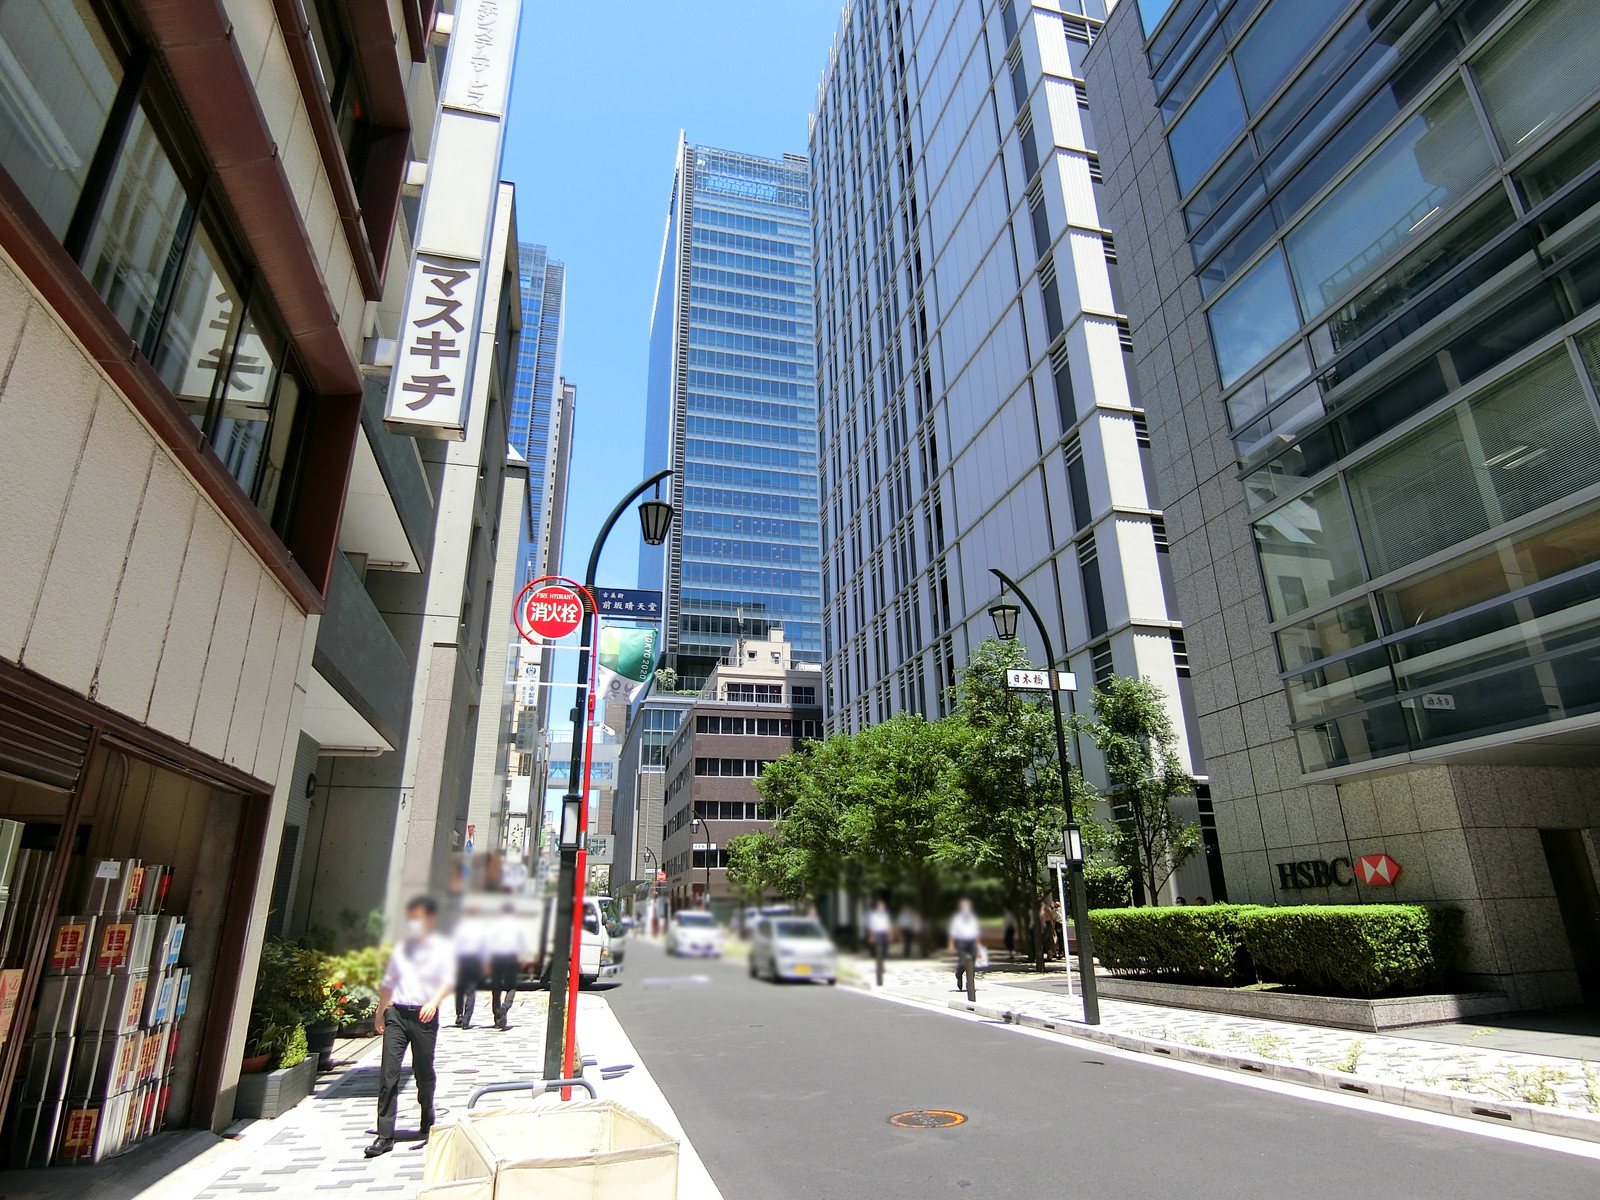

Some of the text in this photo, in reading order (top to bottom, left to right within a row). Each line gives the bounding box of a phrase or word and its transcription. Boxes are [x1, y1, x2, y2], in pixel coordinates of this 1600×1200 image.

[402, 264, 471, 412] マスキチ
[530, 601, 579, 624] 消火栓
[639, 633, 653, 680] TOKYO 2020
[1013, 673, 1044, 686] 日本橋
[1275, 857, 1353, 890] HSBC
